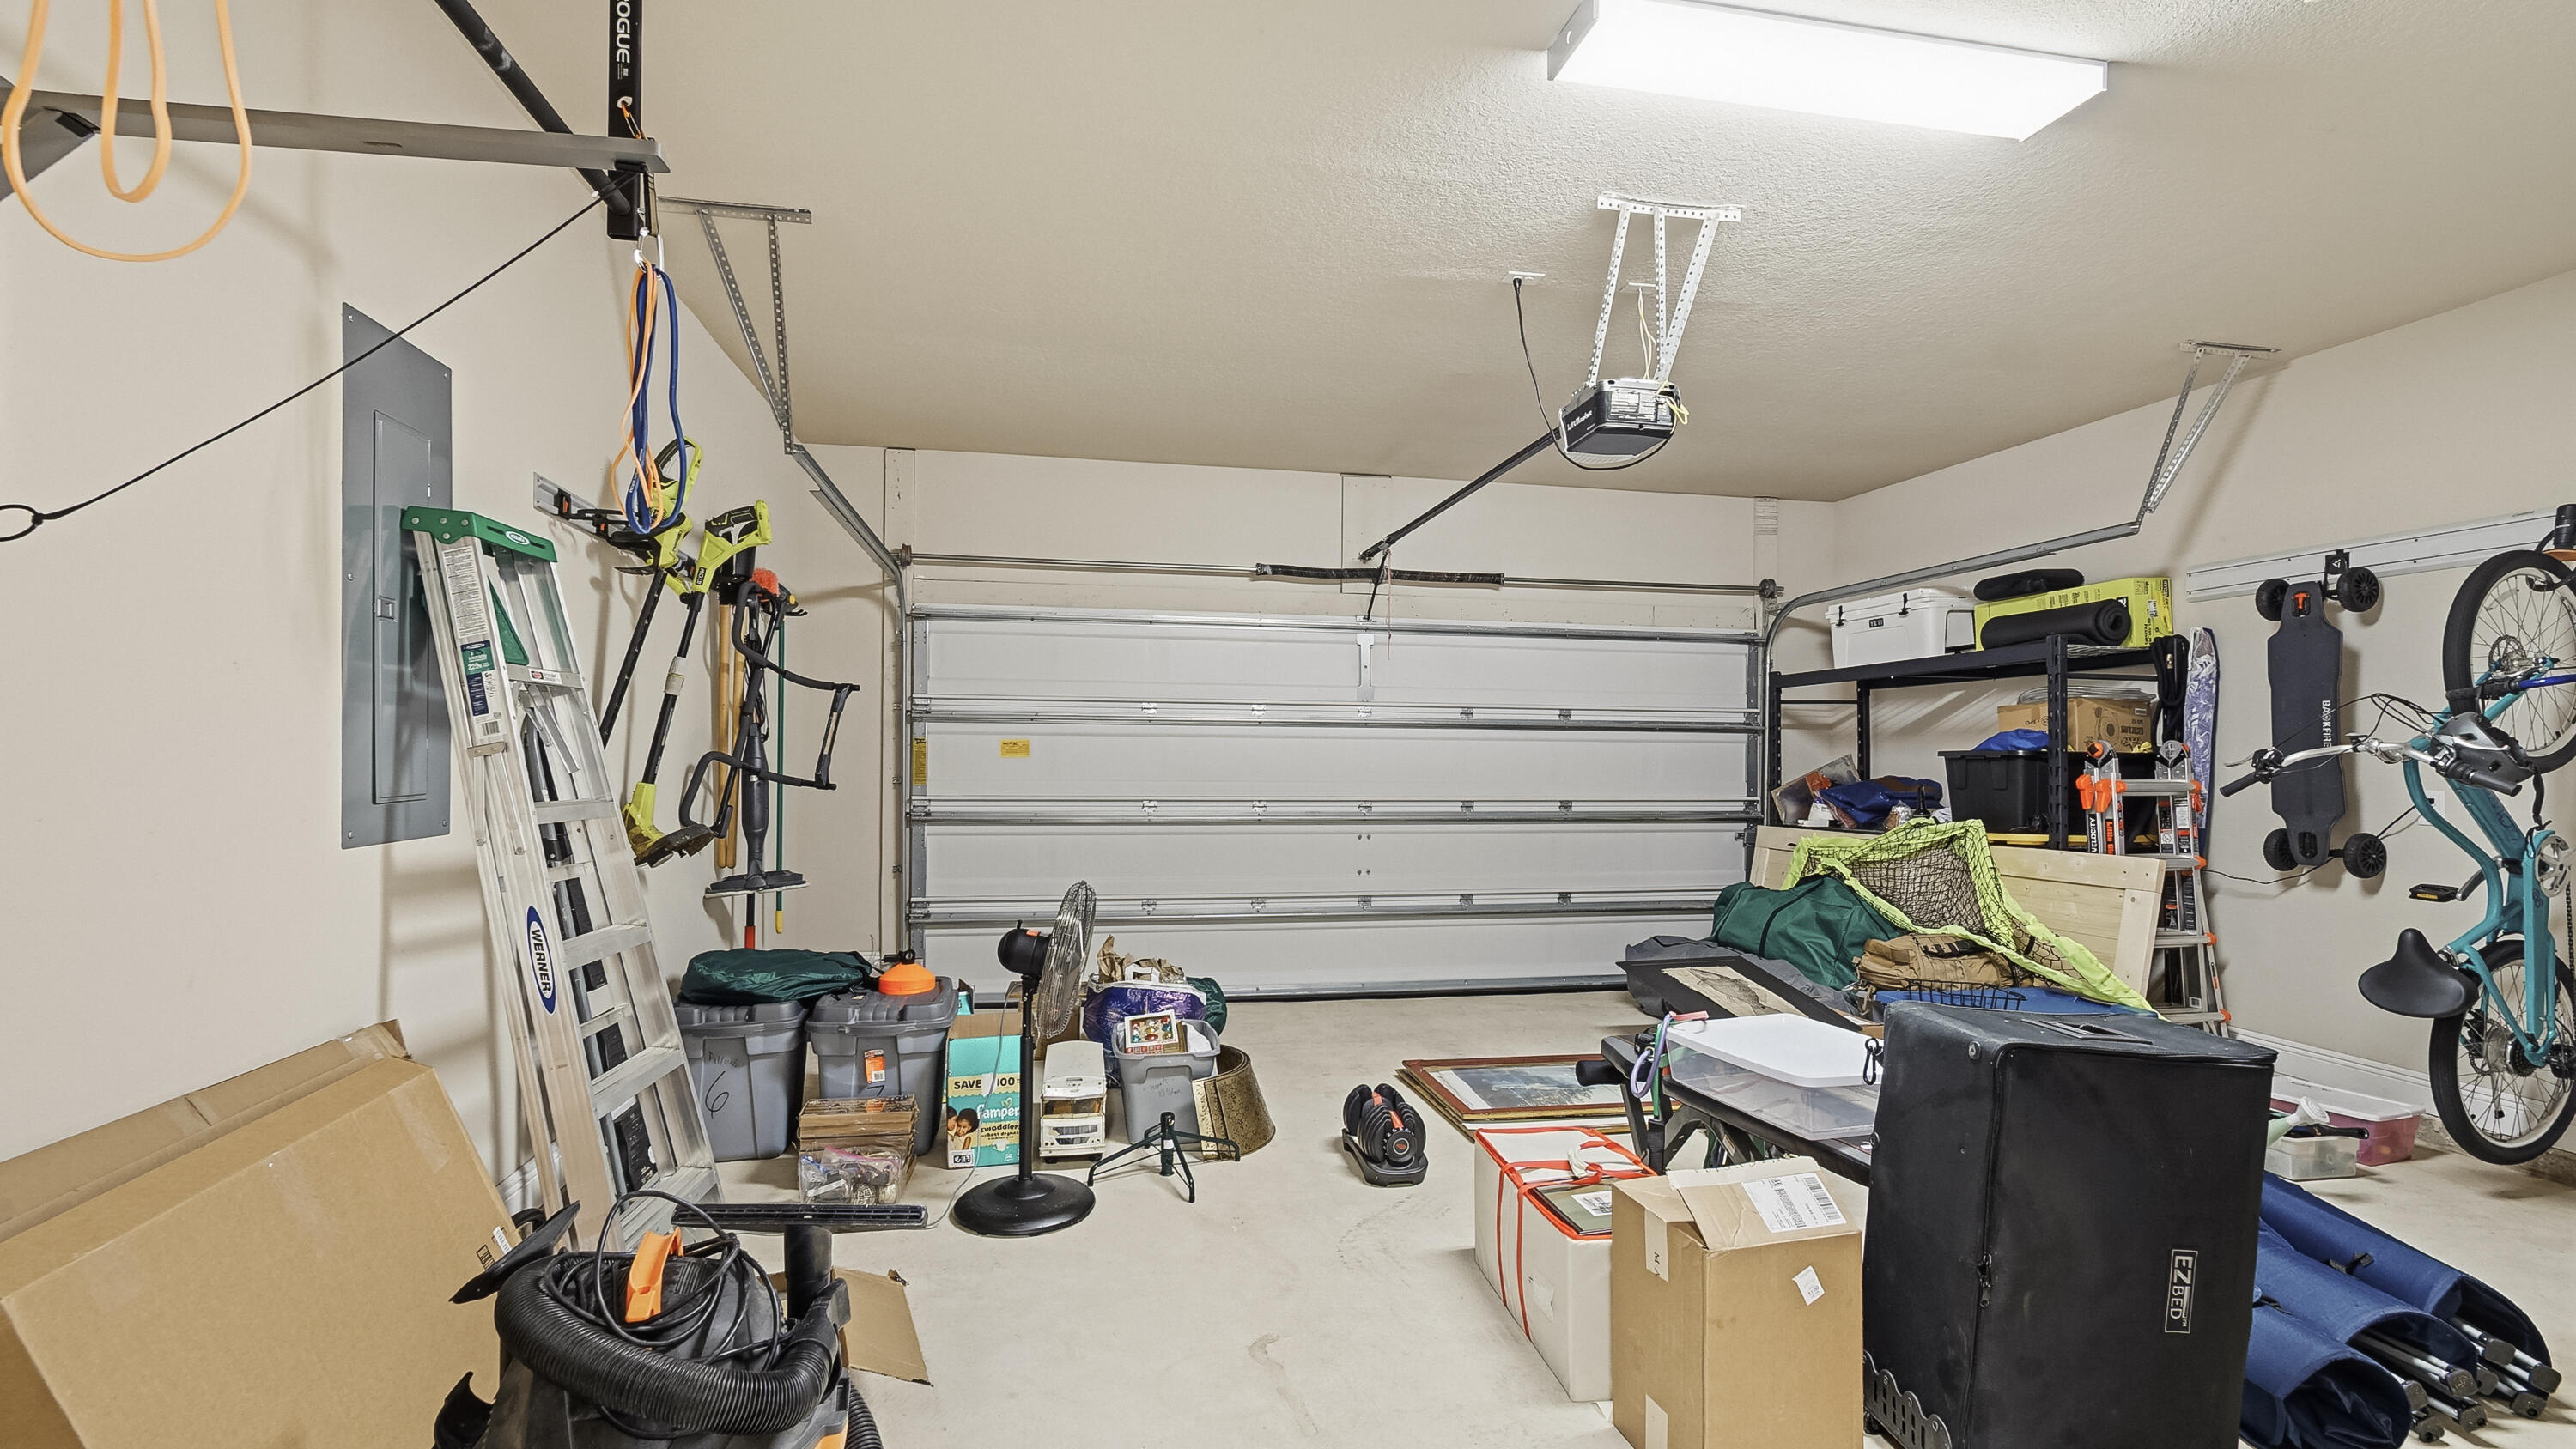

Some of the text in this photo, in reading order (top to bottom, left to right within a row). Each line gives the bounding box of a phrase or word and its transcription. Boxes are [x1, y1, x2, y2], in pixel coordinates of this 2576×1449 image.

[617, 0, 631, 64] OGUE
[1870, 619, 1883, 627] YETI
[2089, 817, 2098, 852] VELOCITY
[531, 929, 552, 992] WERNER
[705, 1070, 730, 1119] 6
[954, 1079, 982, 1090] SAVE
[976, 1104, 1019, 1120] Pamper
[2173, 1256, 2193, 1285] EZ
[2170, 1286, 2184, 1319] BED
